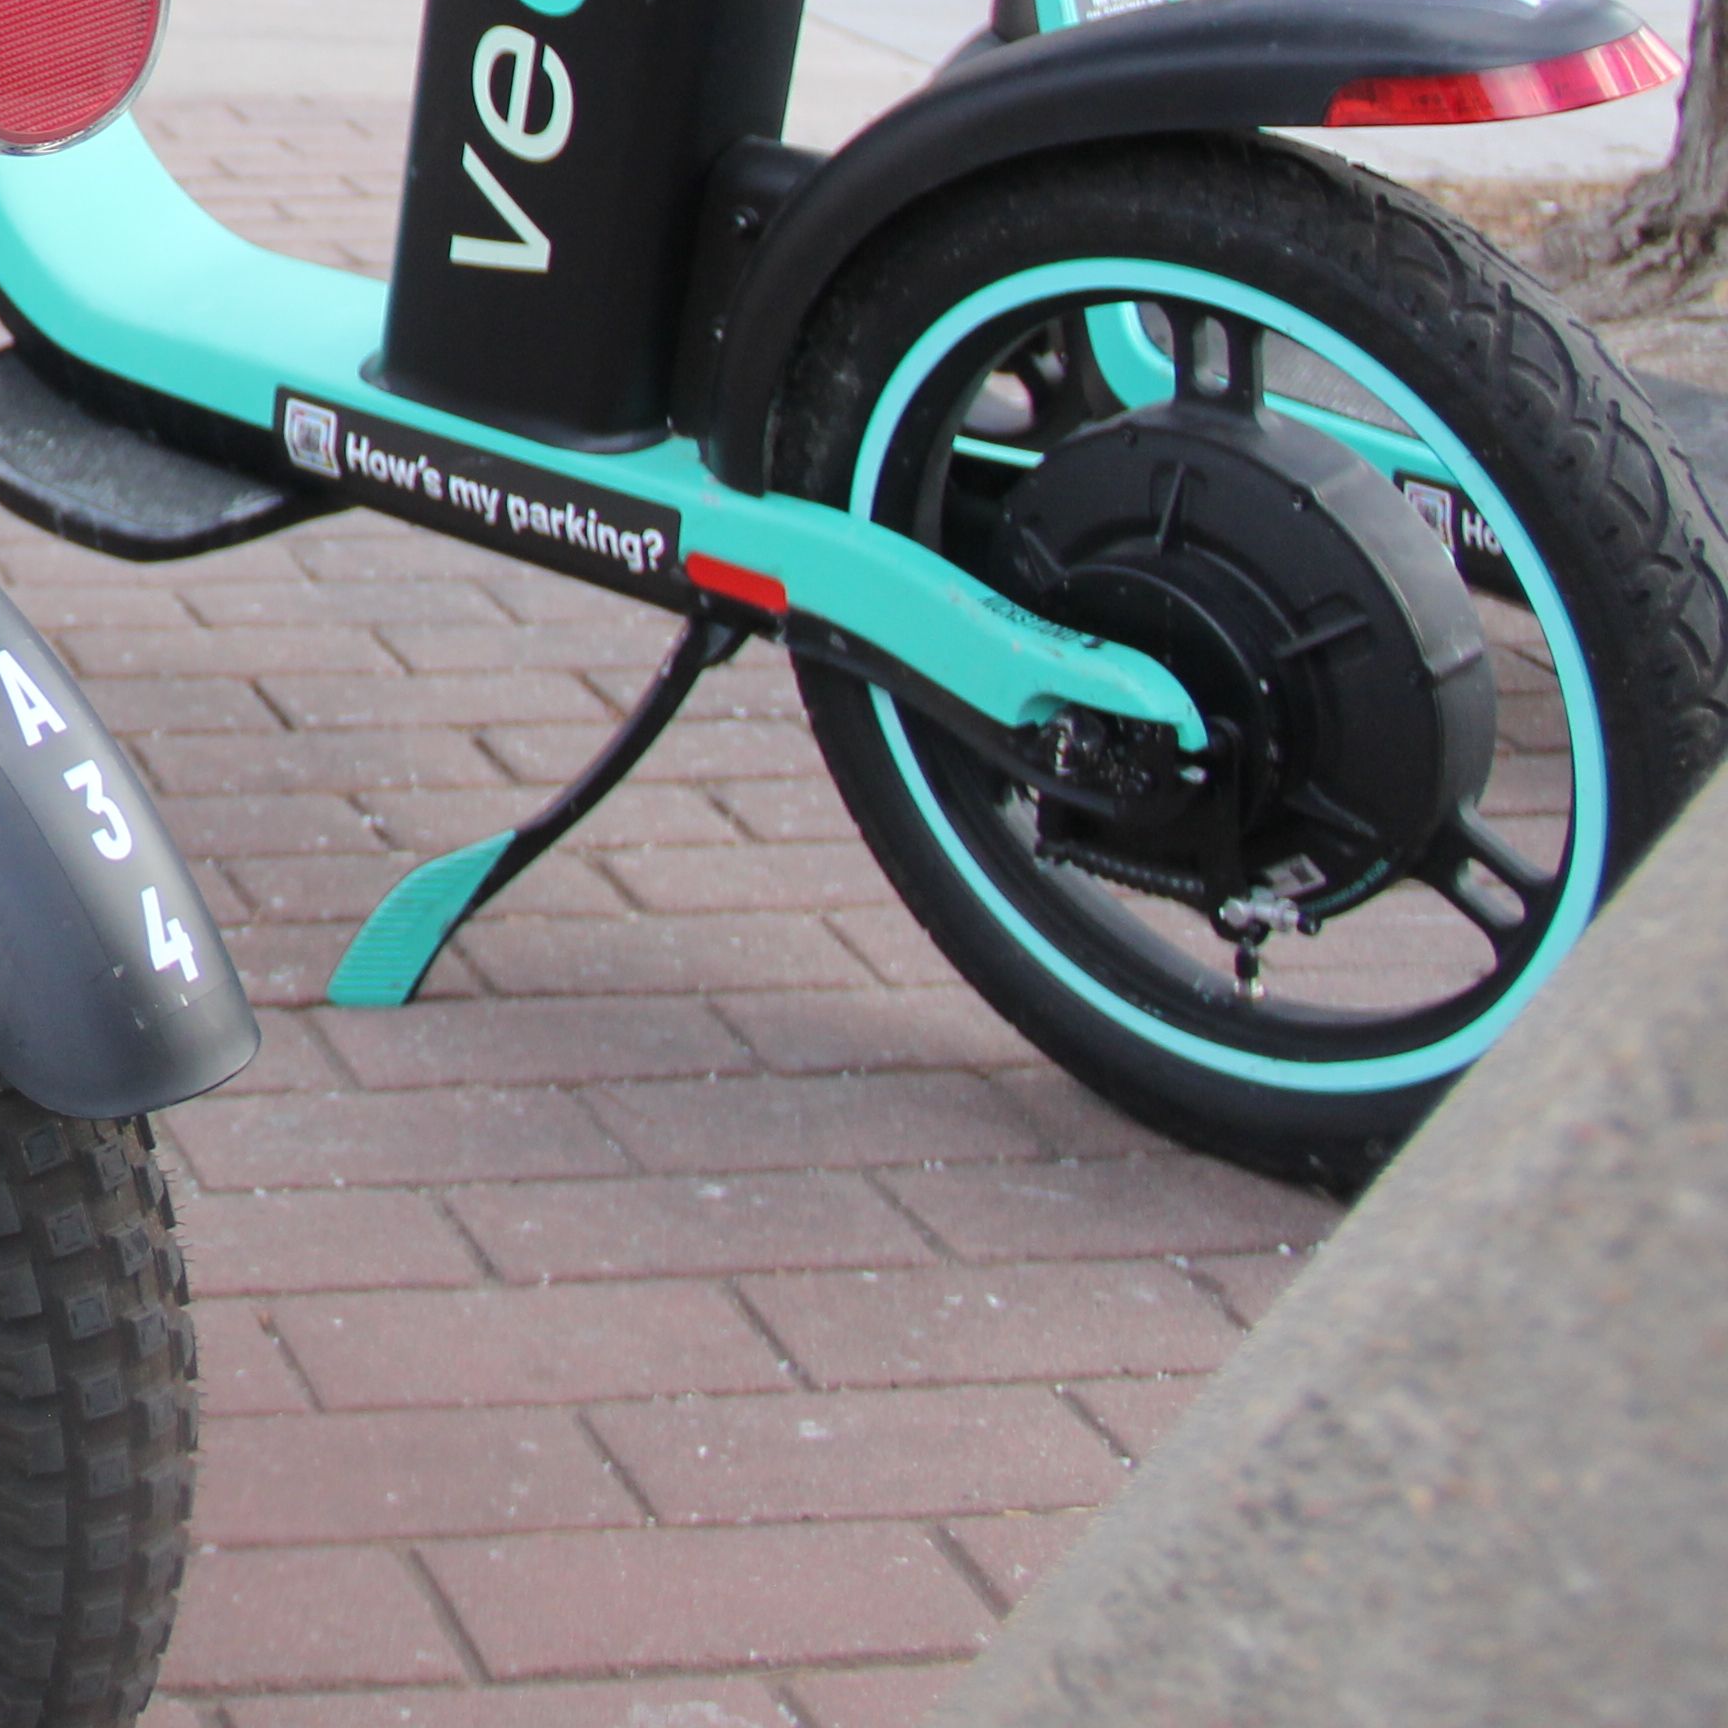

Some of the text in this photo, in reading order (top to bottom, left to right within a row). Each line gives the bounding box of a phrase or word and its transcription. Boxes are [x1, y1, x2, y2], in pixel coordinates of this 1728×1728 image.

[345, 431, 665, 573] How's my parking?
